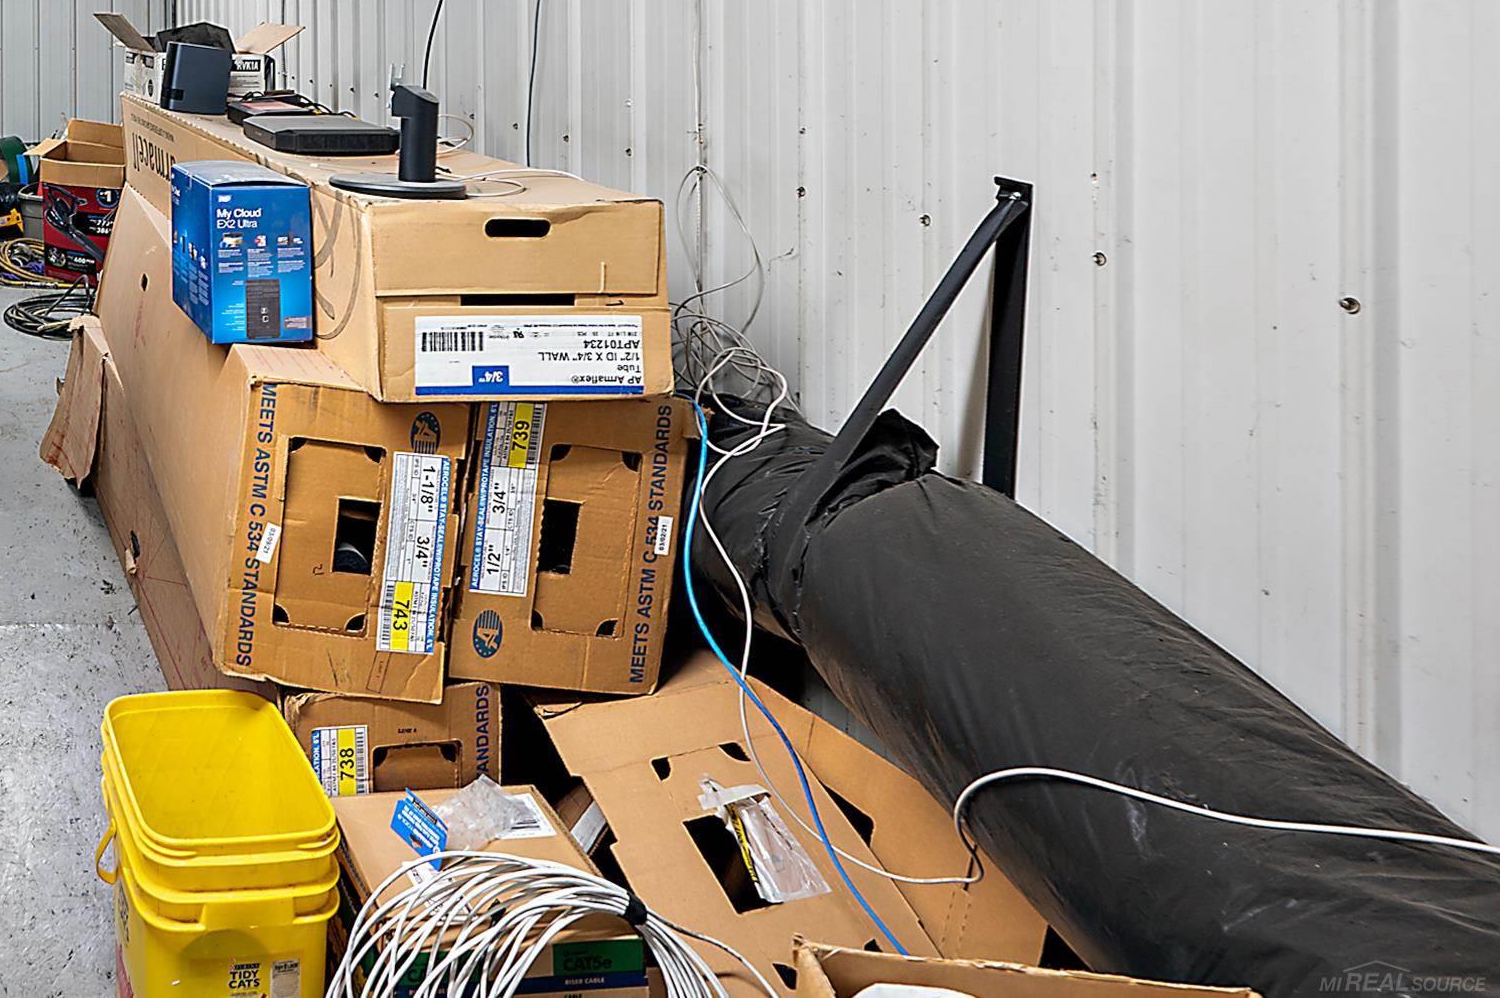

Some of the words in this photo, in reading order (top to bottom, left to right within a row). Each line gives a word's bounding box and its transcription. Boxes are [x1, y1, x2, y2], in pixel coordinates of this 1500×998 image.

[216, 208, 232, 220] My
[233, 208, 262, 218] Cloud
[216, 219, 236, 229] EX2
[237, 219, 258, 228] Ultra
[583, 340, 640, 349] APT01234
[538, 352, 570, 361] WALL
[572, 352, 593, 362] 3/4"
[596, 352, 604, 361] X
[606, 352, 618, 361] ID
[625, 352, 640, 361] 1/2"
[478, 370, 504, 382] 3/4"
[617, 364, 642, 372] Tube
[628, 376, 642, 384] AP
[257, 382, 277, 444] MEETS
[511, 420, 530, 451] 739
[648, 405, 672, 511] STANDARDS
[252, 447, 270, 499] ASTM
[420, 466, 436, 513] 1-1/8"
[492, 482, 507, 514] 3/4"
[250, 503, 266, 517] C
[248, 521, 263, 552] 534
[416, 536, 430, 568] 3/4"
[487, 544, 501, 575] 1/2"
[643, 551, 657, 564] C
[637, 568, 656, 619] ASTM
[236, 557, 260, 667] STANDARDS
[393, 599, 410, 631] 743
[630, 622, 649, 683] MEETS
[476, 685, 489, 776] ANDARDS
[339, 747, 355, 780] 738
[563, 954, 612, 972] CAT5e
[230, 970, 259, 981] TIDY
[584, 977, 605, 985] CABLE
[229, 979, 260, 990] CATS
